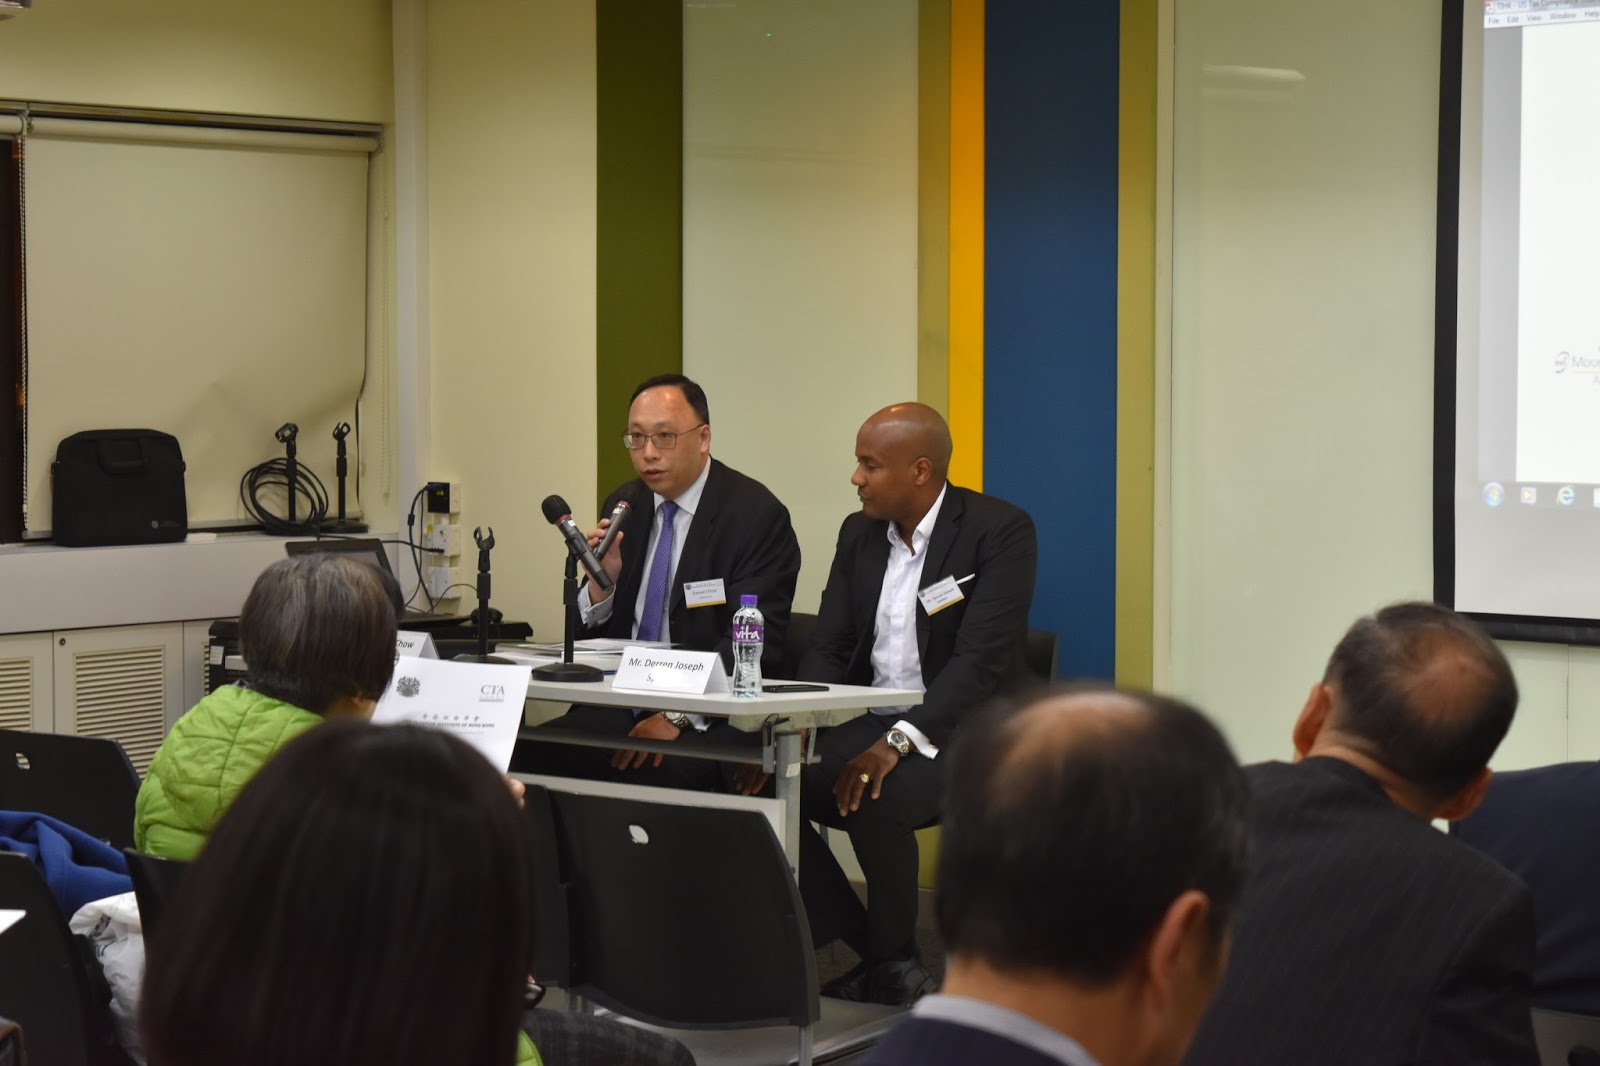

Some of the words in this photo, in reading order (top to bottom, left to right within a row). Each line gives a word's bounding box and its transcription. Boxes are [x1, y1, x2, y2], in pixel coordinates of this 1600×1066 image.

[1585, 10, 1600, 18] Help
[735, 624, 760, 640] vita
[628, 658, 642, 667] Mr.
[644, 658, 673, 669] Derren
[675, 661, 704, 672] Joseph
[480, 684, 505, 695] CTA
